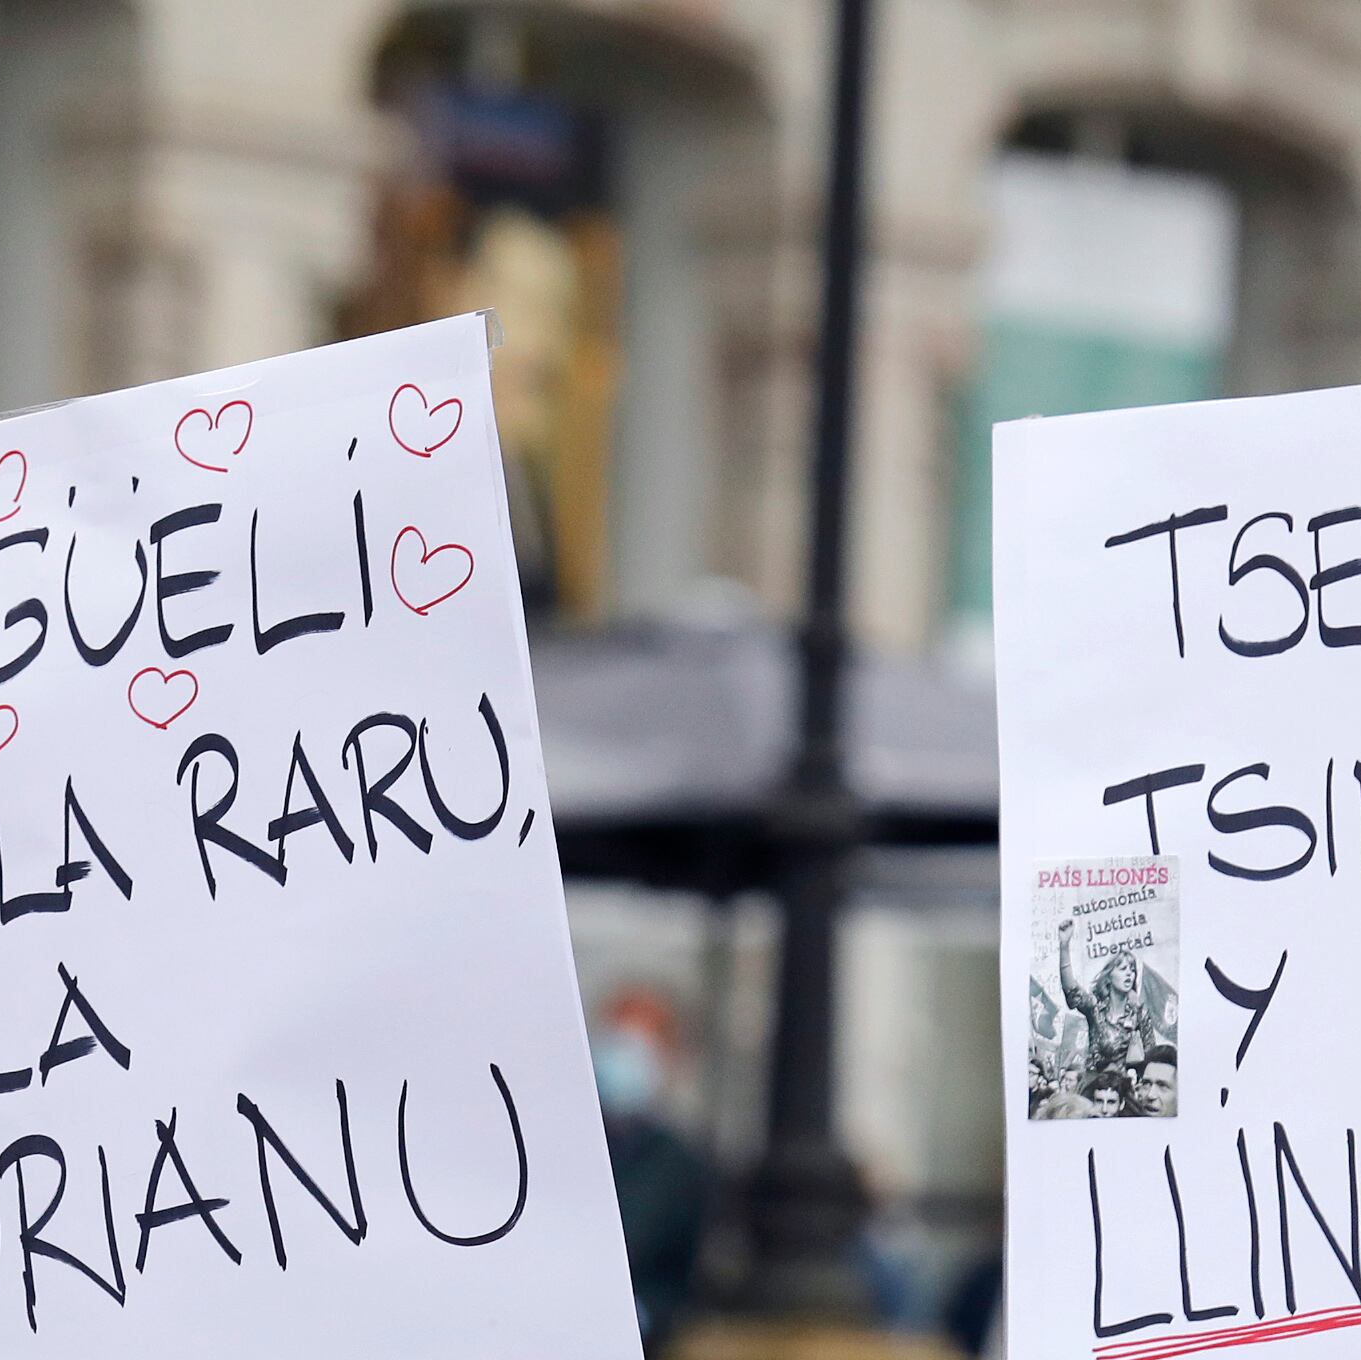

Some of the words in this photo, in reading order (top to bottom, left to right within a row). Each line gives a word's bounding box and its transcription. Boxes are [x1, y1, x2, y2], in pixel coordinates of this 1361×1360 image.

[176, 692, 536, 901] RARU,
[1038, 865, 1082, 888] PAÍS
[1086, 863, 1169, 886] LLIONÉS
[1072, 884, 1157, 916] autonomía
[1086, 911, 1147, 942] justicia
[1086, 931, 1154, 959] libertad
[1204, 949, 1288, 1071] Y
